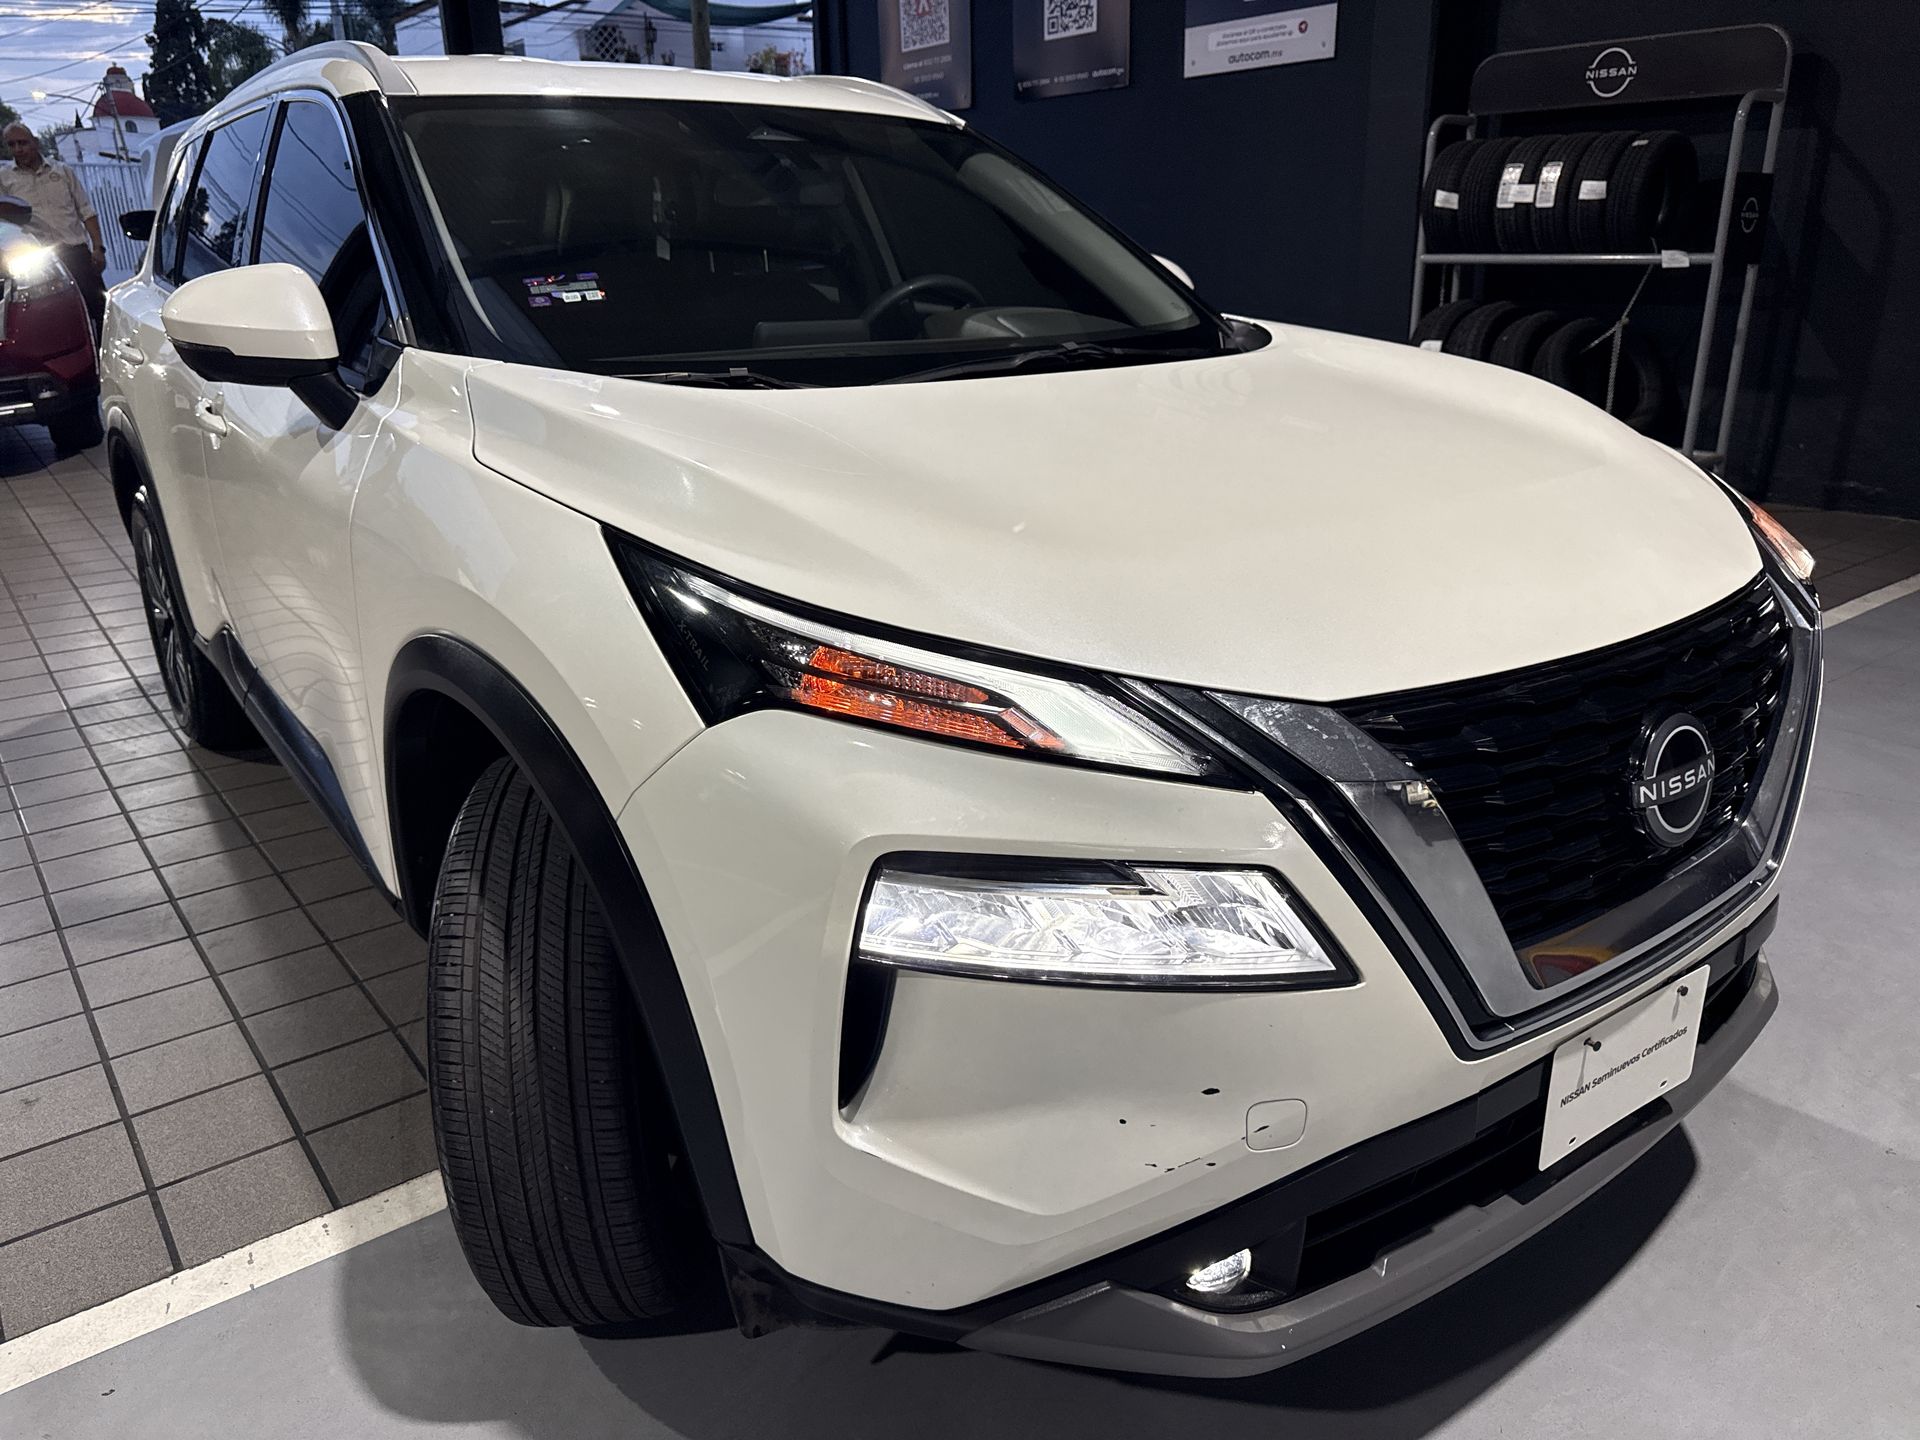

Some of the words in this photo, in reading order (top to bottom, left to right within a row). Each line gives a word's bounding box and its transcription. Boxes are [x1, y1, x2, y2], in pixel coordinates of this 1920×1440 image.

[1585, 65, 1637, 79] NISSAN
[677, 619, 710, 671] X-TRAIL
[1639, 756, 1715, 804] NISSAN
[1560, 1082, 1591, 1108] NISSAN
[1591, 1053, 1640, 1089] Seminuevos
[1641, 1026, 1688, 1058] Certificados
